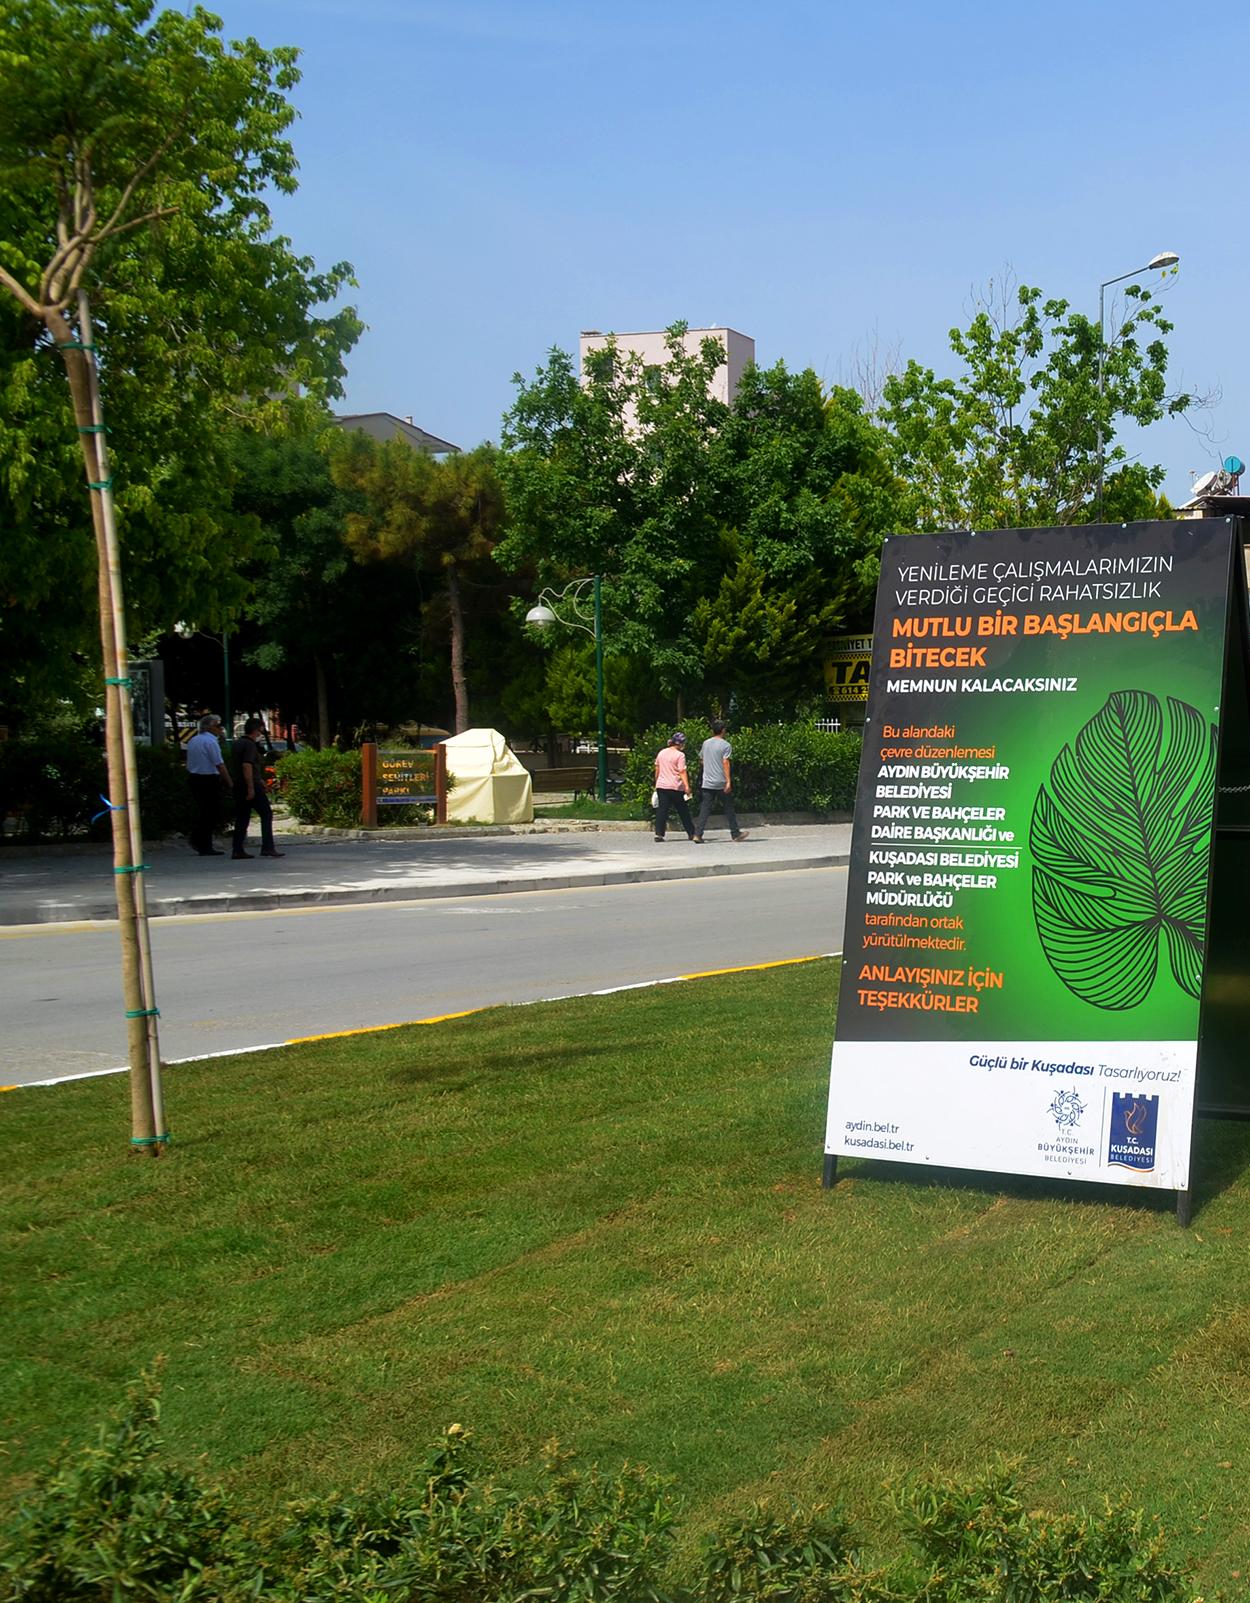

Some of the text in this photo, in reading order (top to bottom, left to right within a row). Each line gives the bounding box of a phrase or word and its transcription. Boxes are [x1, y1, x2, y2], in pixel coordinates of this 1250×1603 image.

[898, 556, 1173, 583] YENİLEME ÇALIŞMALARIMIZIN
[895, 581, 1162, 607] VERDİĞİ GEÇİCİ RAHATSIZLIK
[892, 610, 1199, 640] MUTLU BİR BAŞLANGIÇLA
[889, 642, 988, 669] BİTECEK
[886, 677, 1078, 693] MEMNUN KALACAKSINIZ
[882, 725, 955, 738] Bu alandaki
[879, 745, 996, 761] çevre düzenlemesi
[877, 762, 1010, 782] AYDIN BÜYÜKŞEHİR
[875, 783, 952, 799] BELEDİYESİ
[873, 806, 1006, 823] PARK VE BAHÇELER
[871, 823, 1015, 843] DAİRE BAŞKANLIĞI ve
[869, 850, 1020, 868] KUŞADASI BELEDİYESİ
[867, 871, 997, 891] PARK ve BAHÇELER
[866, 889, 953, 908] MÜDÜRLÜĞÜ
[865, 913, 964, 930] tarafından ortak
[862, 932, 966, 951] yürütülmektedir.
[858, 965, 1003, 992] ANLAYIŞINIZ İÇİN
[857, 989, 979, 1013] TEŞEKKÜRLER
[969, 1055, 1182, 1083] Güçlü bir Kuşadası Tasarlıyoruz!
[844, 1120, 900, 1135] aydin.bel.tr
[844, 1136, 915, 1153] kusadasi.bel.tr
[1037, 1143, 1095, 1156] BÜYÜKŞEHİR
[1055, 1137, 1079, 1145] AYDIN
[1044, 1155, 1088, 1165] BELEDİYESİ
